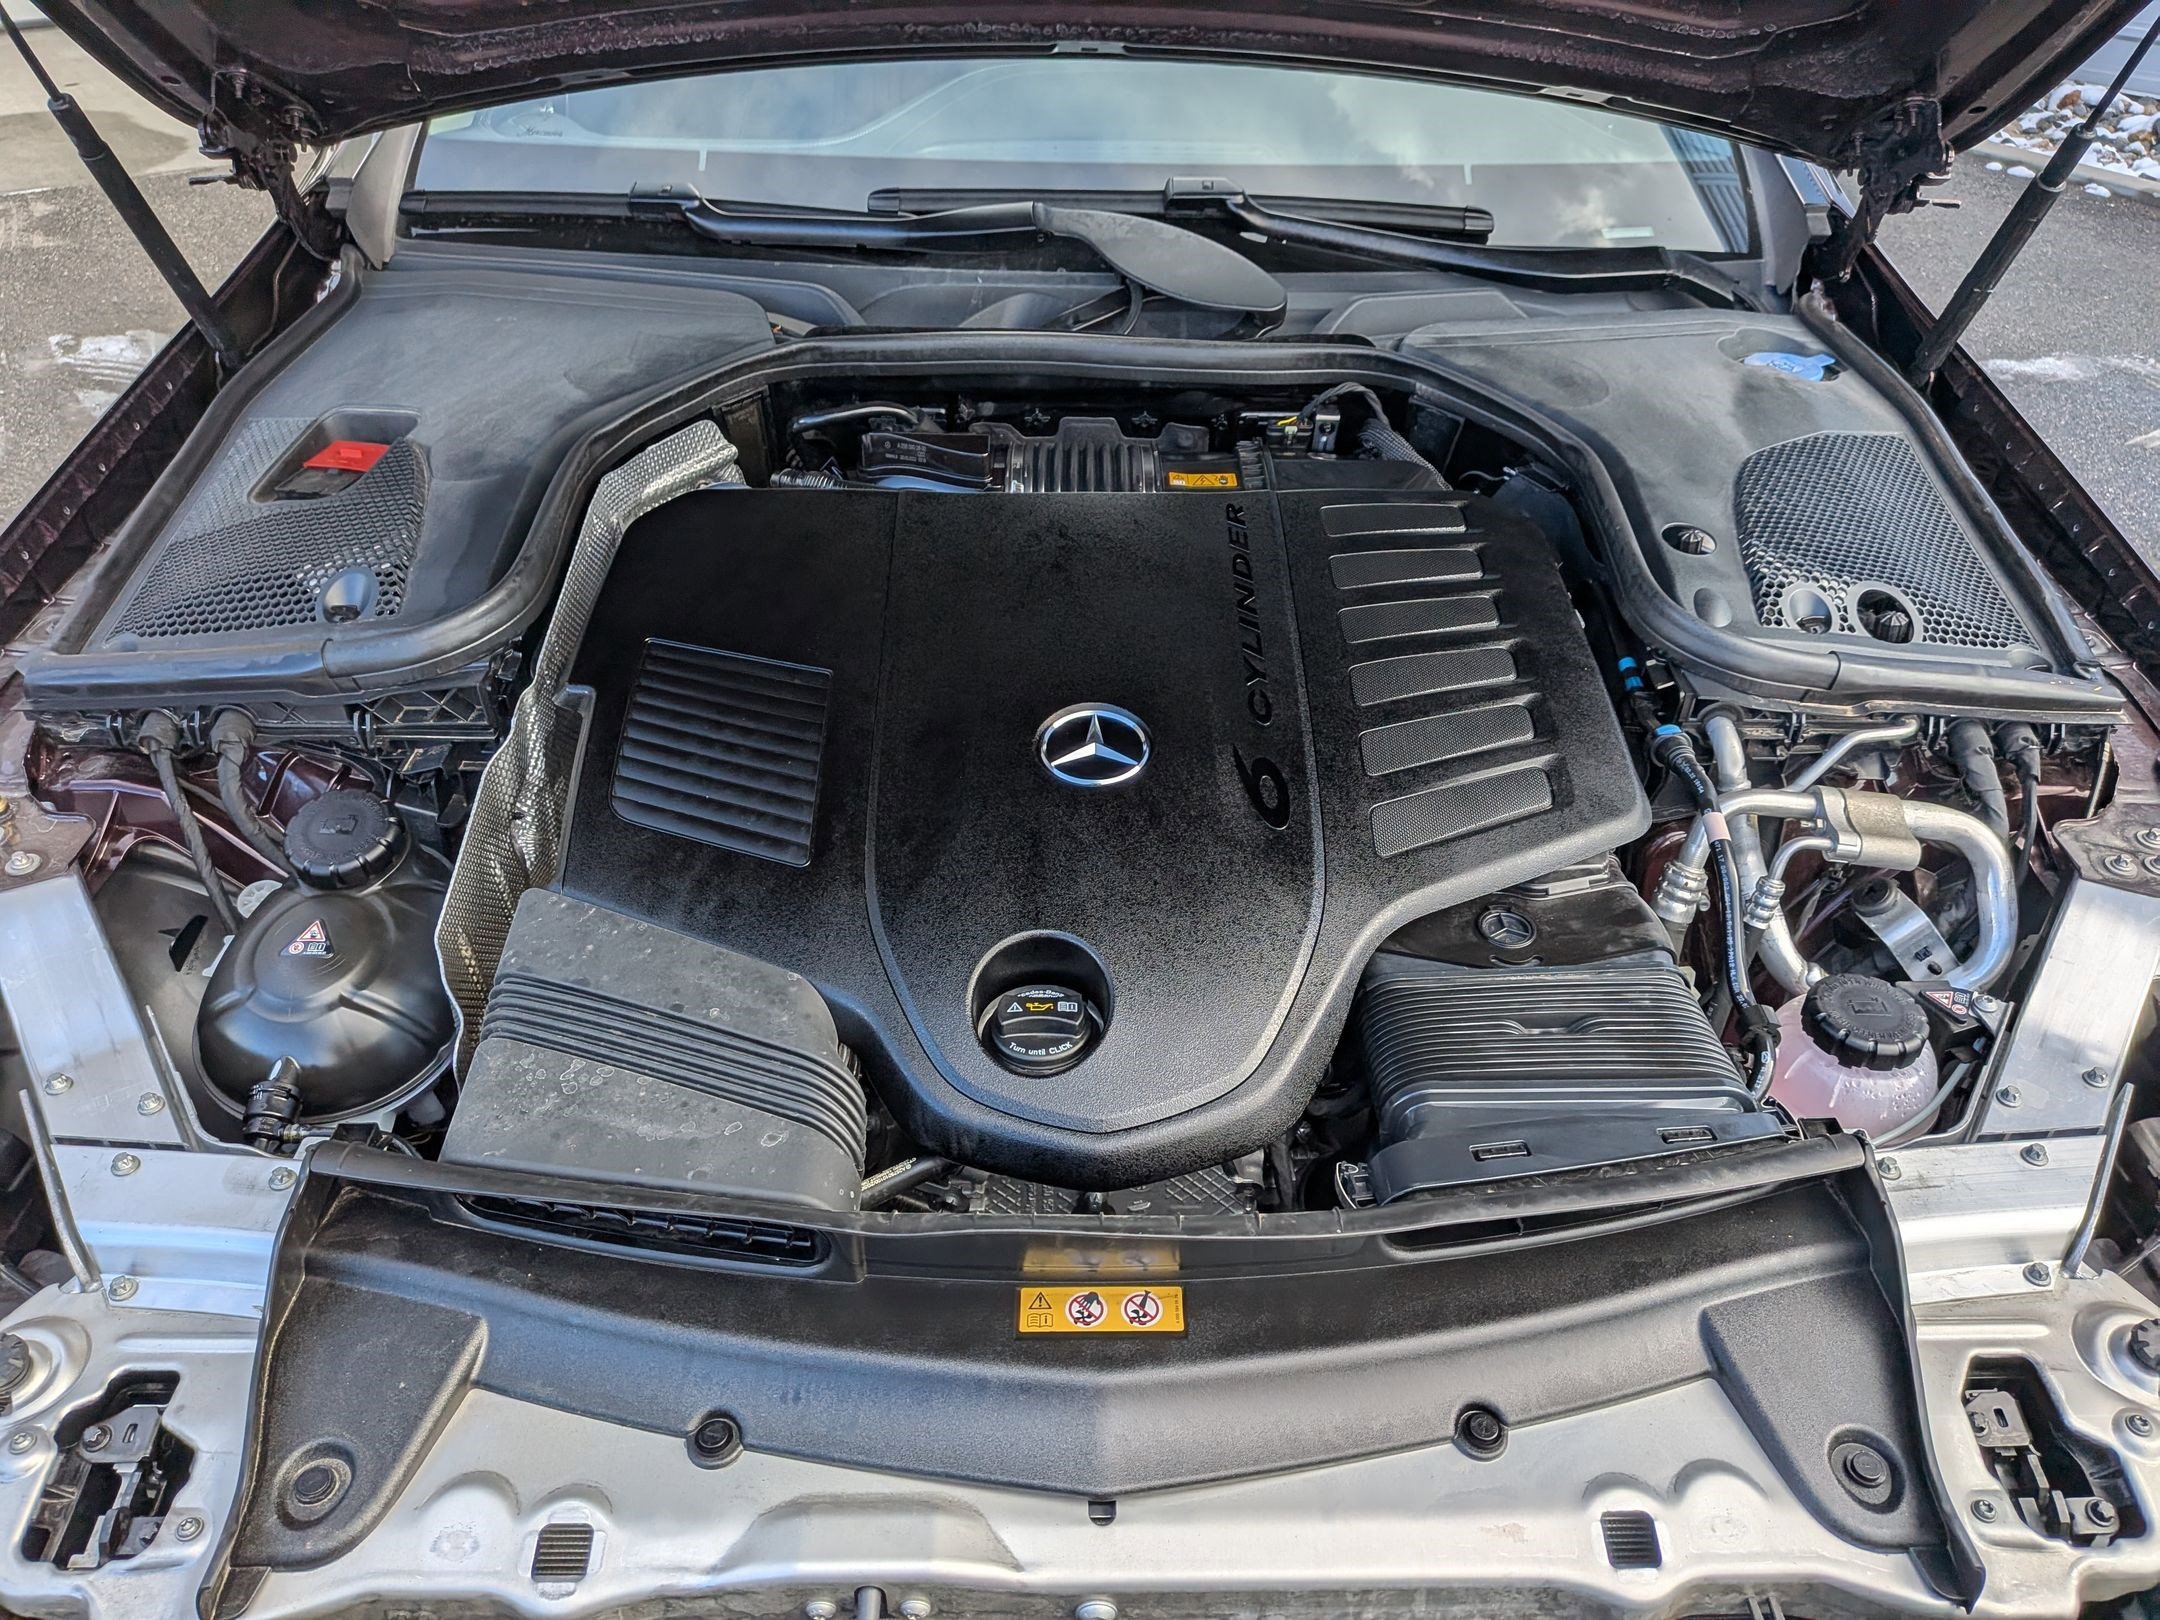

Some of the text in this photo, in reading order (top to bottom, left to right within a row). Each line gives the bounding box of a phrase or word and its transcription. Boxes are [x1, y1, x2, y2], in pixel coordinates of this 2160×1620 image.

[1226, 503, 1291, 831] 6 CYLINDER
[1009, 1041, 1073, 1056] Turn until CLICK
